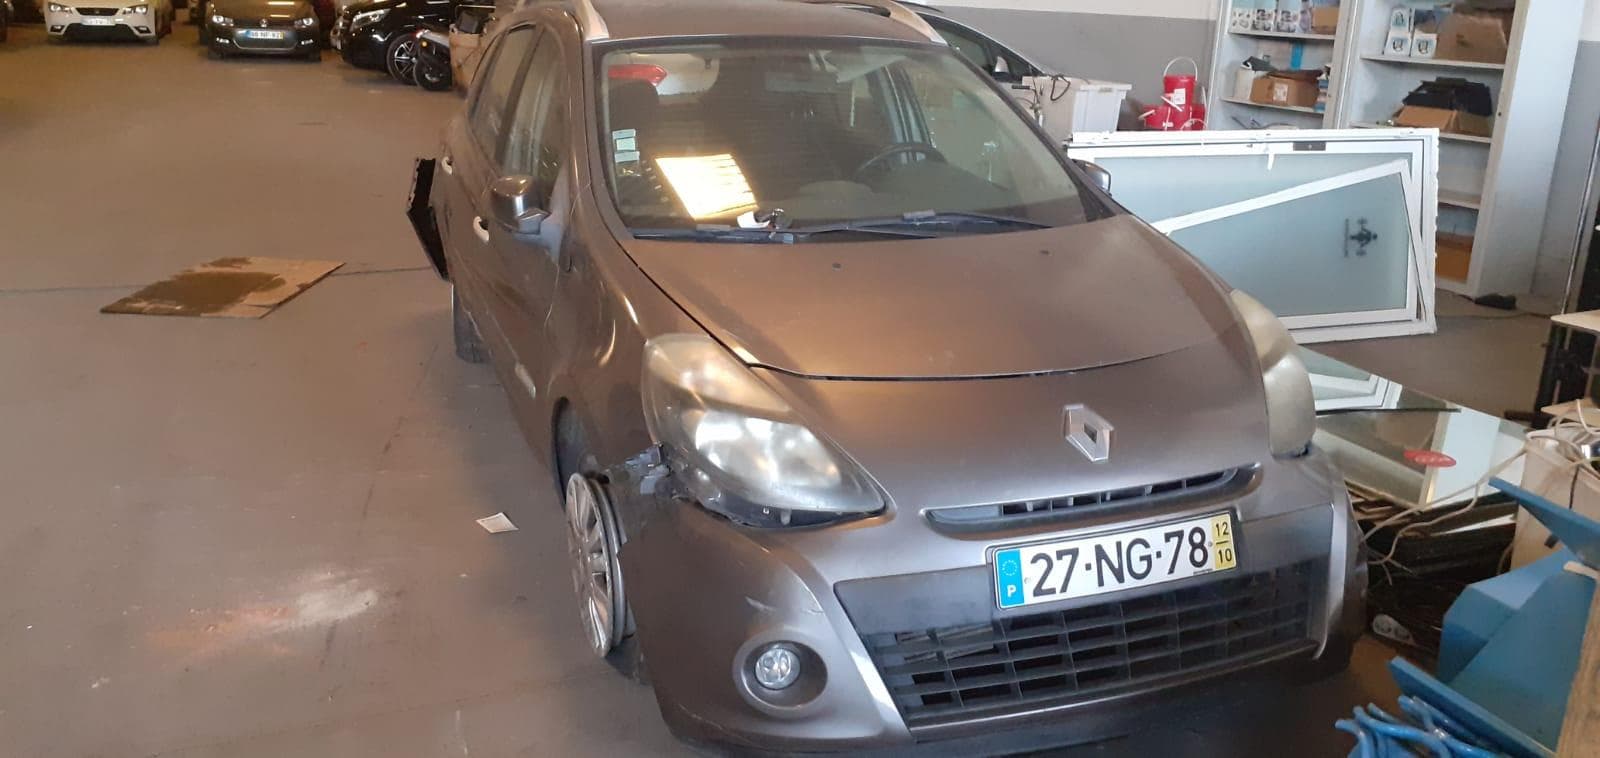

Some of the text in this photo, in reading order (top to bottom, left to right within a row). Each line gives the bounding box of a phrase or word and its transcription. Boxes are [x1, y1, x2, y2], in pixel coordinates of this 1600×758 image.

[1215, 521, 1229, 537] 12
[1218, 547, 1233, 564] 10
[1007, 585, 1017, 598] P
